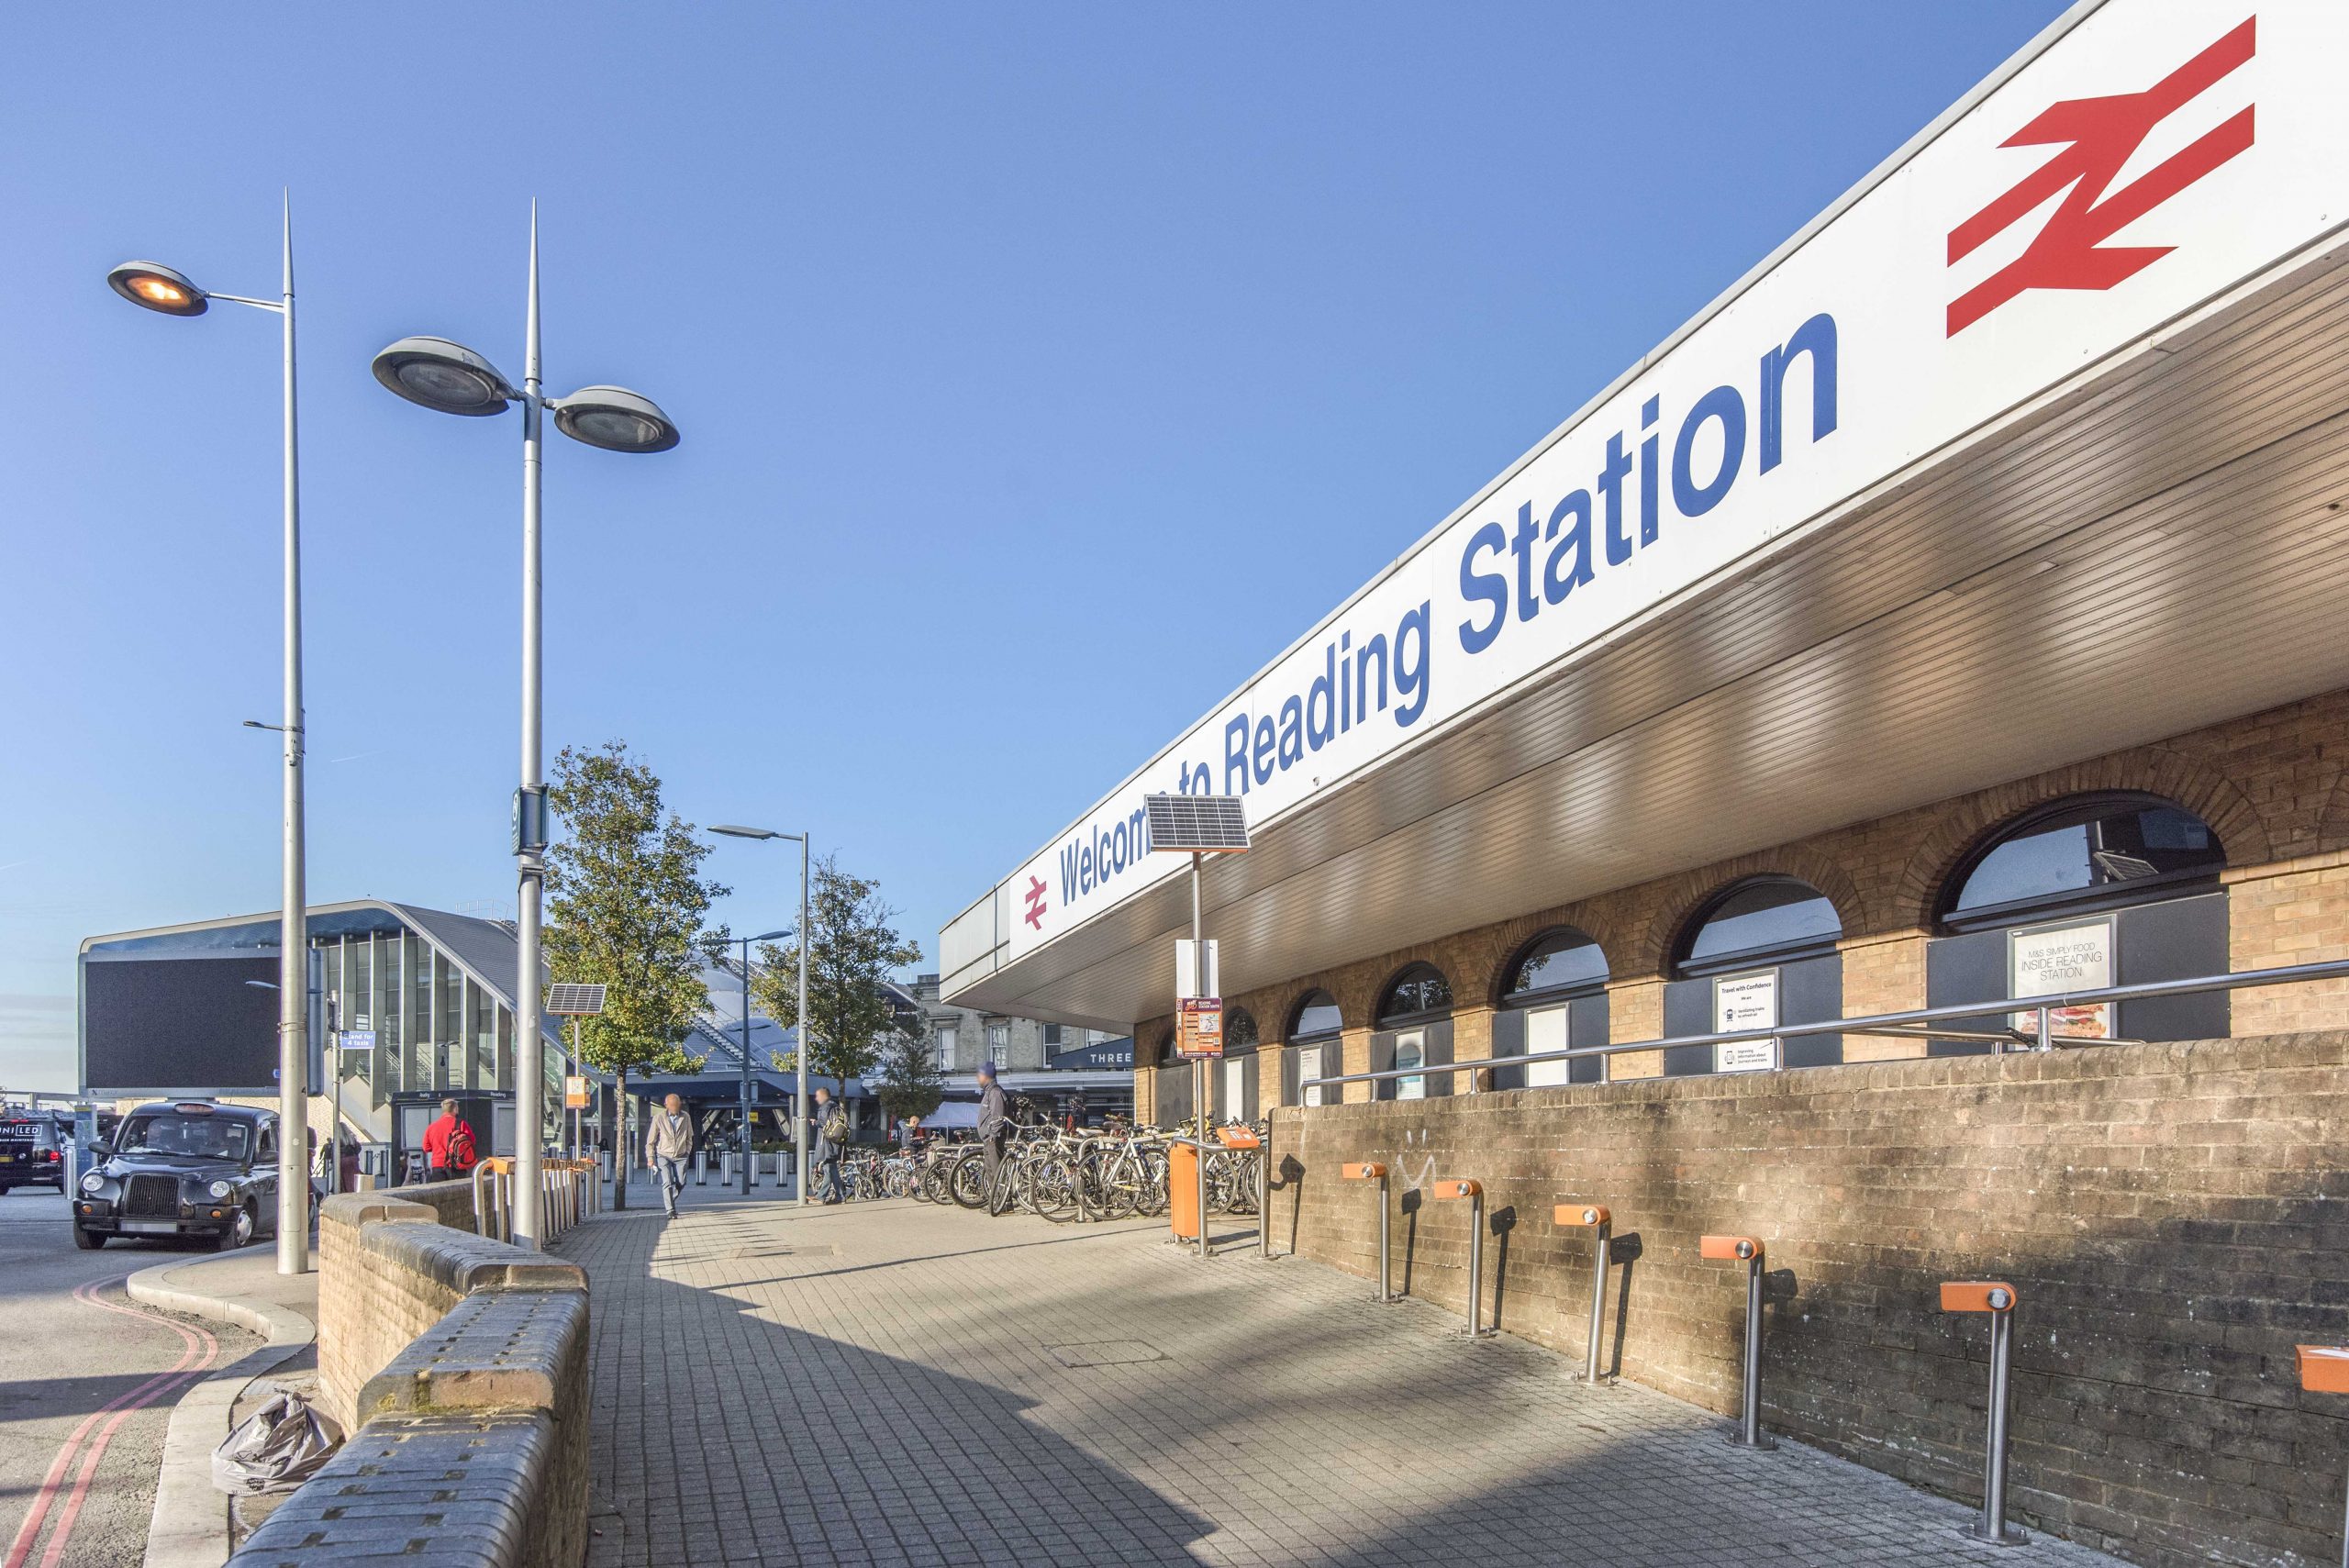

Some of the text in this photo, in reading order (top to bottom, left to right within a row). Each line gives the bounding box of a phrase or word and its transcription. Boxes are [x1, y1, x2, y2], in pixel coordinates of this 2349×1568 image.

[1060, 790, 1167, 906] Welcom
[1225, 599, 1431, 796] Reading
[1459, 313, 1837, 654] Station
[2028, 942, 2096, 958] M&S SIMPLY FOOD
[2021, 951, 2102, 972] INSIDE READING
[2040, 967, 2082, 982] STATION
[1746, 982, 1772, 991] Confidence
[1090, 1053, 1131, 1063] THREE
[301, 1086, 306, 1095] 4
